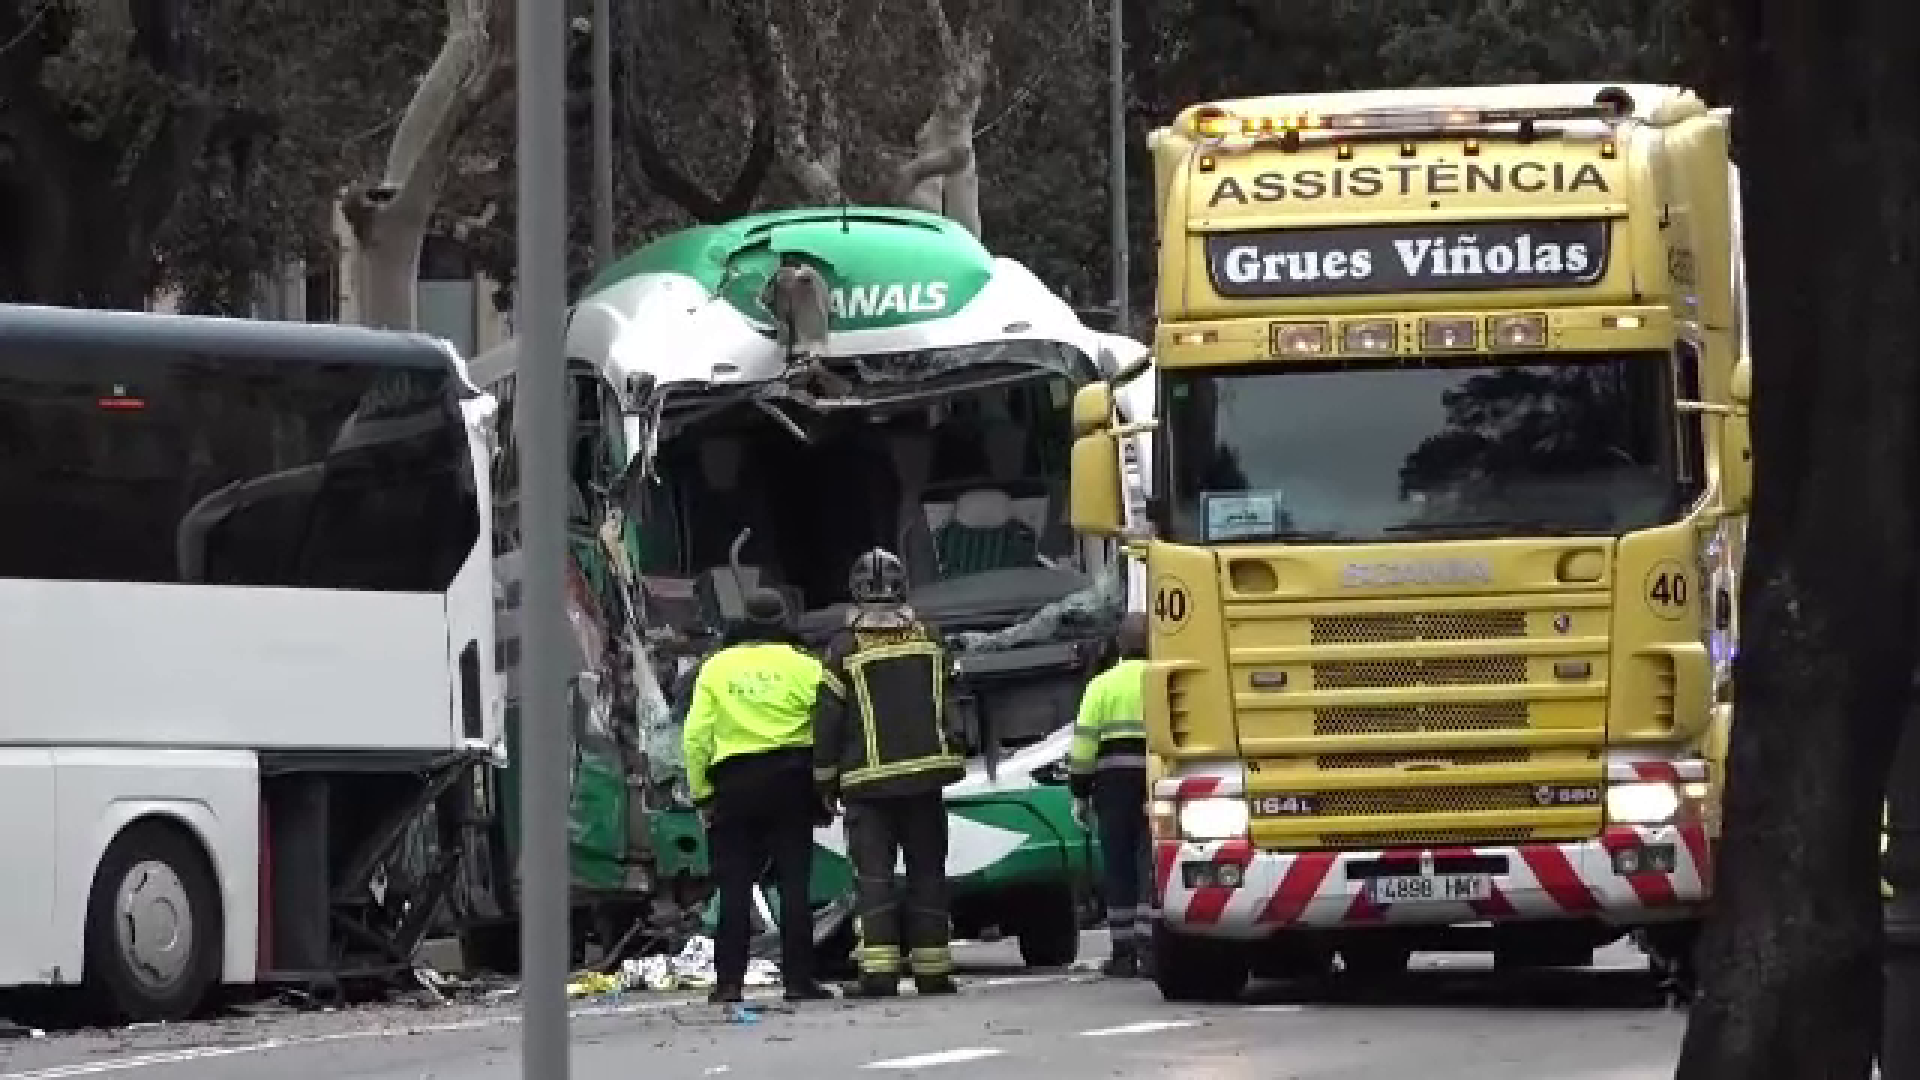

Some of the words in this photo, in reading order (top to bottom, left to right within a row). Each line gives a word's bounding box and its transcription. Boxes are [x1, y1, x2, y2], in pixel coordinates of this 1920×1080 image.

[1225, 242, 1372, 283] Grues
[1393, 234, 1588, 279] Viñolas
[830, 281, 949, 318] ANALS
[1154, 588, 1186, 622] 40
[1650, 573, 1687, 606] 40
